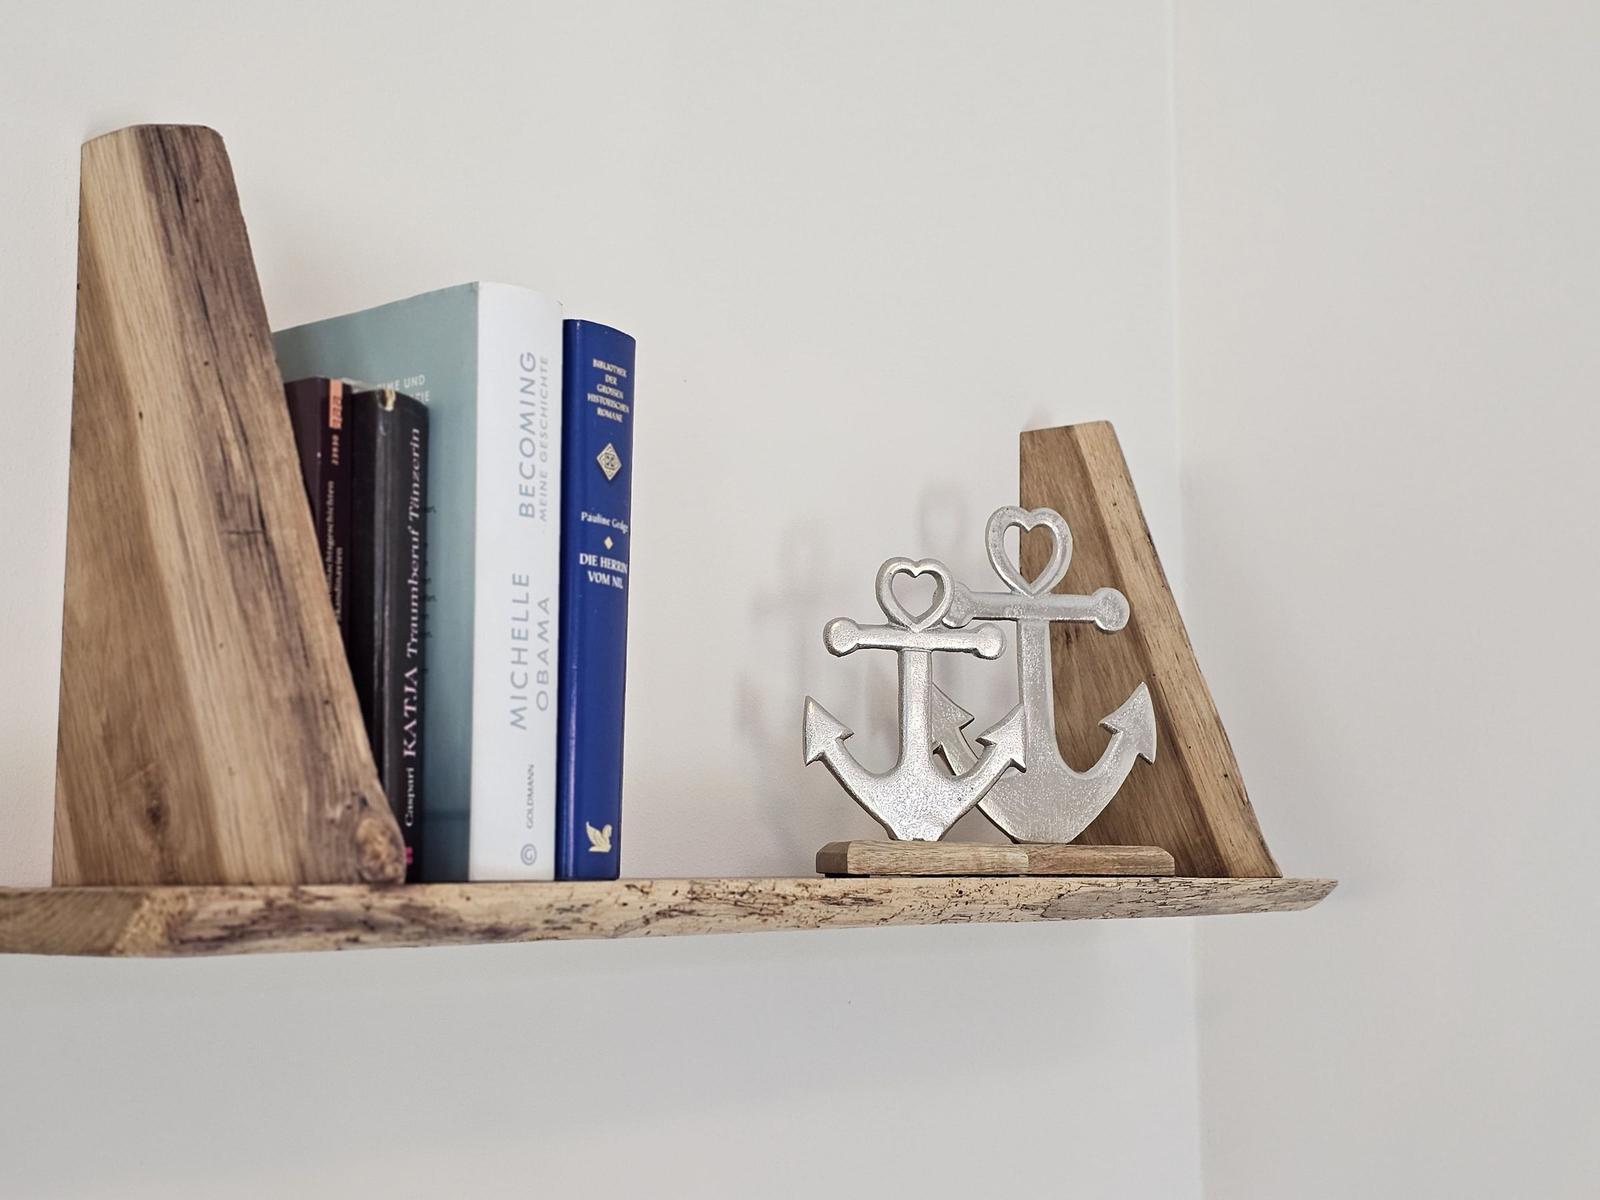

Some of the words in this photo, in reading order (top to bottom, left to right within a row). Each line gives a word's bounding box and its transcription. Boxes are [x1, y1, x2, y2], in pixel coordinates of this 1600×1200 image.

[403, 374, 426, 389] UND
[538, 356, 549, 463] GESCHICHTE
[604, 374, 618, 386] DER
[518, 351, 537, 519] BECOMING
[596, 407, 623, 423] ROMANE
[408, 427, 420, 521] Tänzerin
[538, 470, 549, 523] MEINE
[581, 511, 611, 527] Pauline
[579, 552, 599, 567] DIE
[587, 570, 611, 586] VOM
[612, 575, 624, 590] NIL
[407, 525, 420, 658] Traumberuf
[509, 572, 530, 730] MICHELLE
[535, 596, 551, 712] OBAMA
[402, 667, 418, 758] KATJA
[405, 767, 416, 827] Caspari
[525, 763, 536, 830] GOLDMANN
